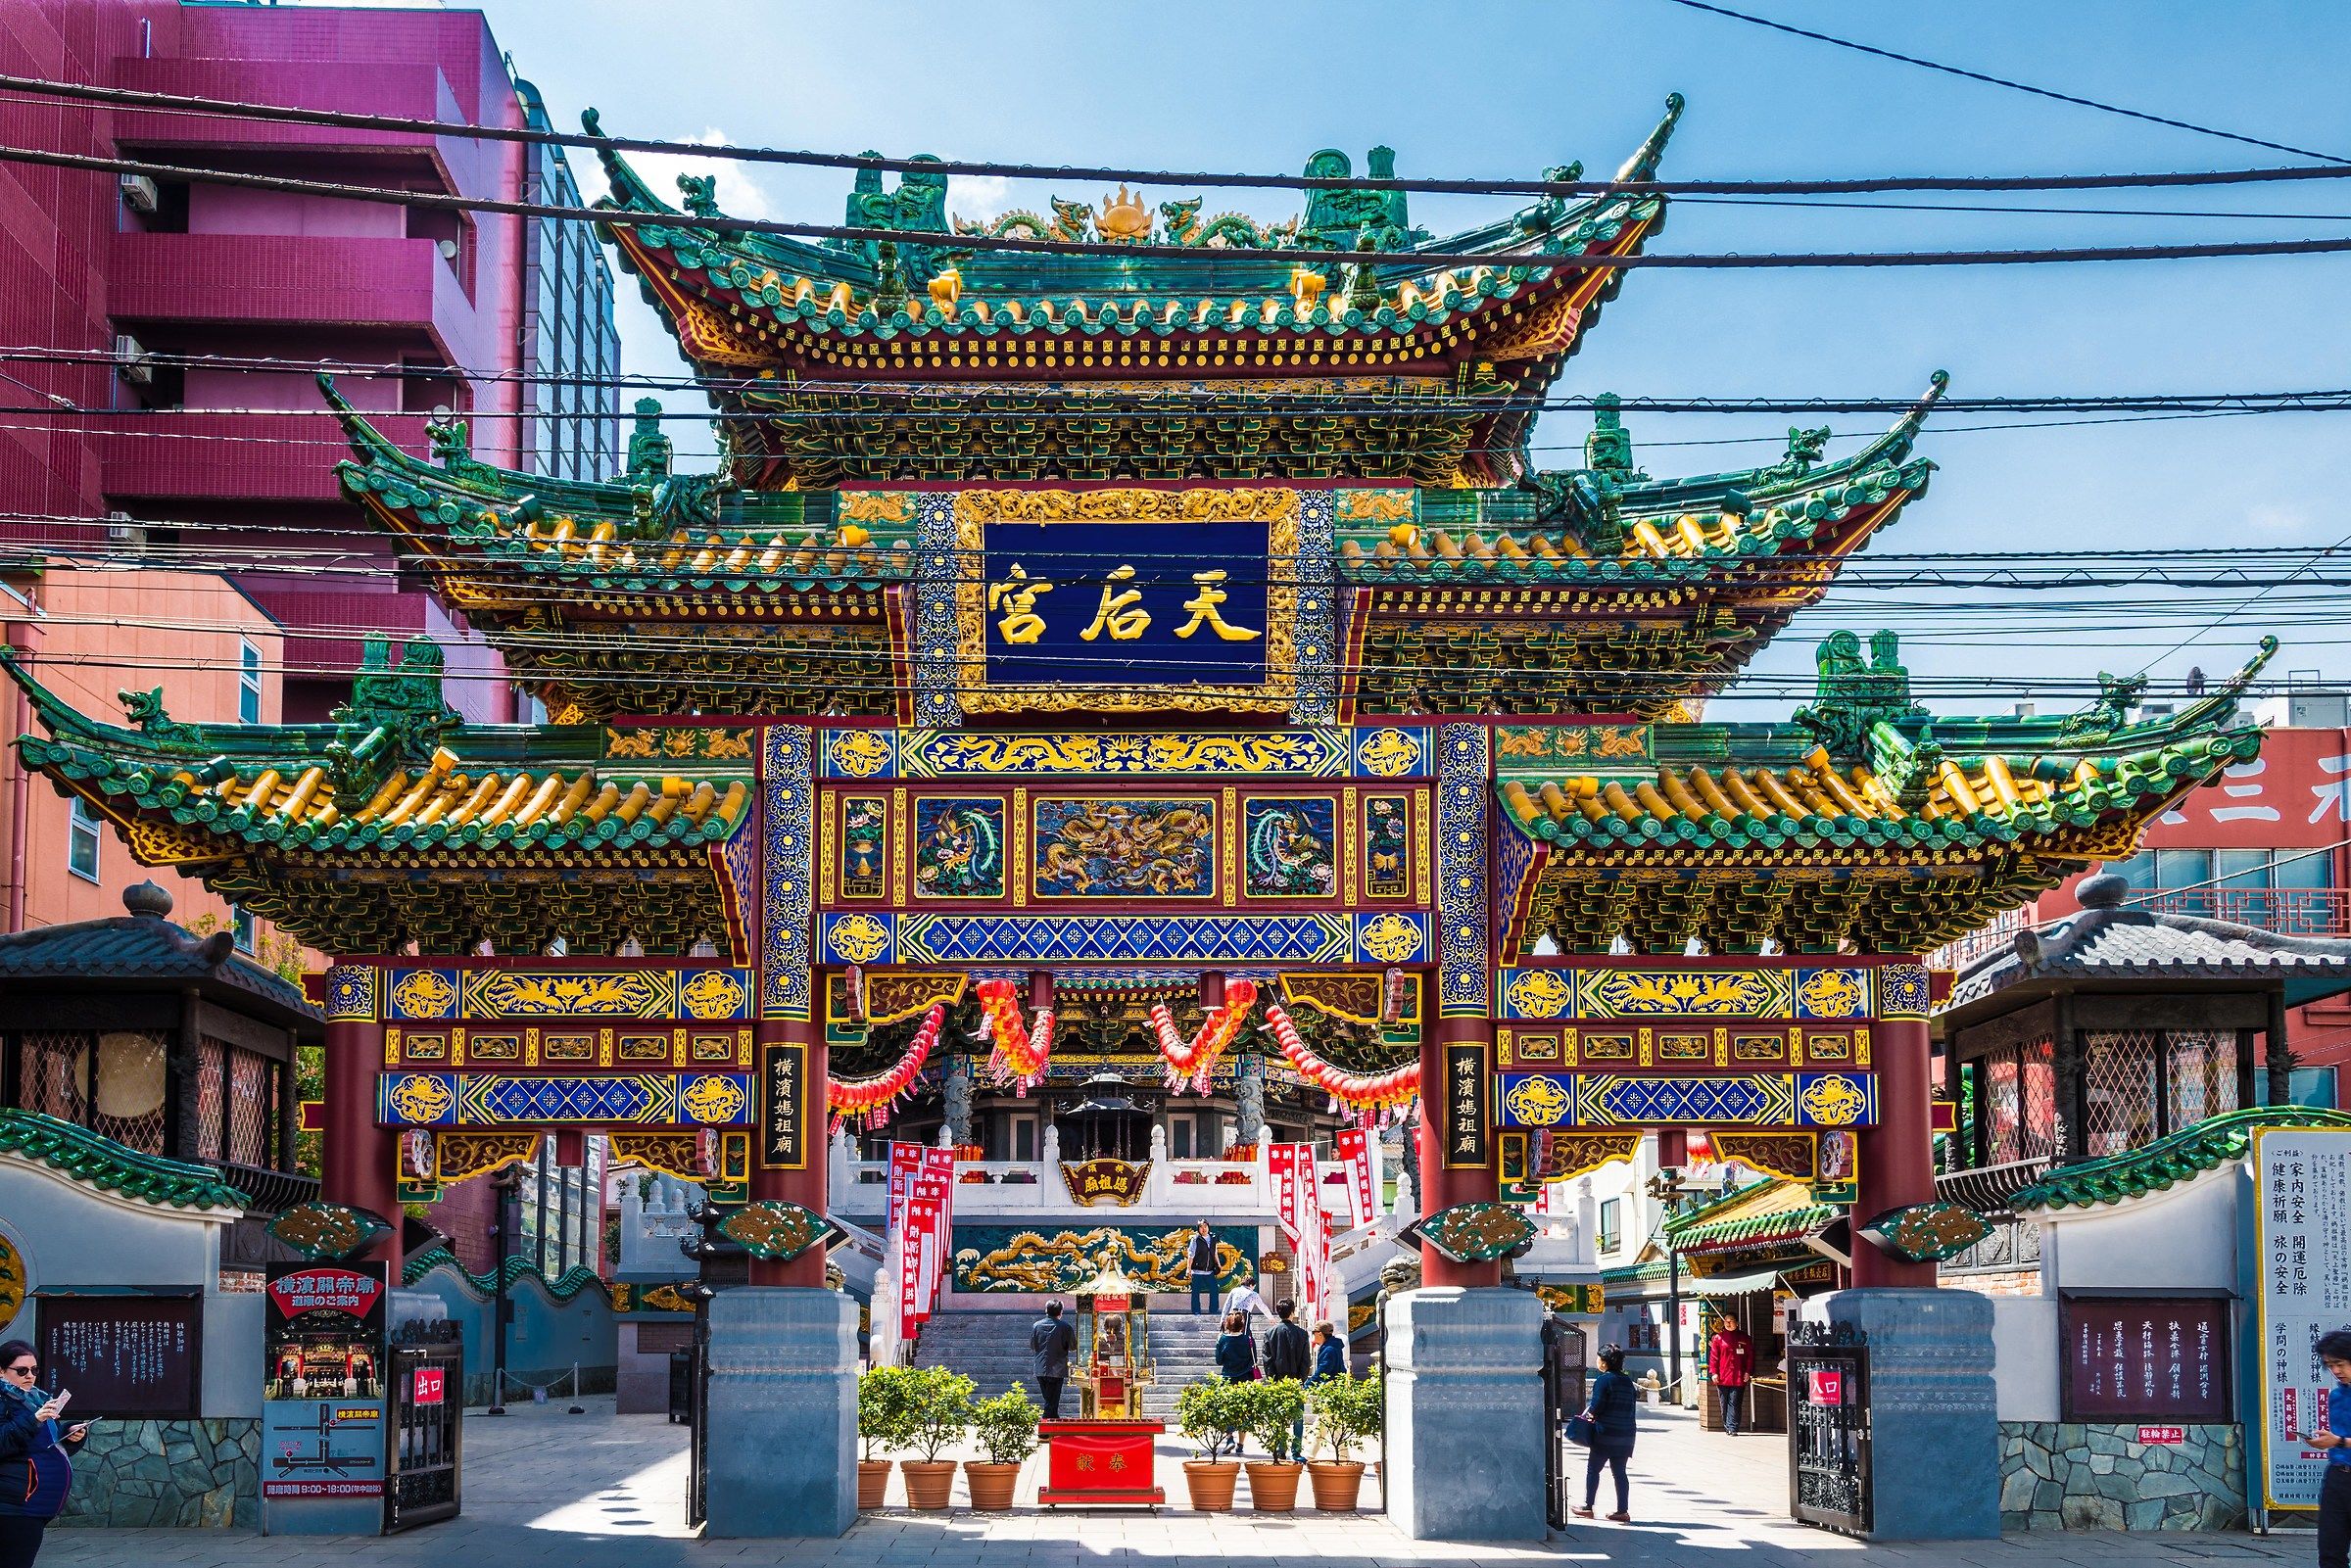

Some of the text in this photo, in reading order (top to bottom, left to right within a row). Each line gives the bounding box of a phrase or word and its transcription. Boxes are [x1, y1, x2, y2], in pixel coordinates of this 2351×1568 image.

[988, 562, 1262, 643] 天后宮
[2272, 1162, 2289, 1295] 健康祈願 旅の安全
[2290, 1162, 2308, 1296] 家内安全 開運厄除
[418, 1375, 441, 1396] 出口
[1811, 1379, 1838, 1395] 入口
[2275, 1322, 2288, 1383] 学問の神様
